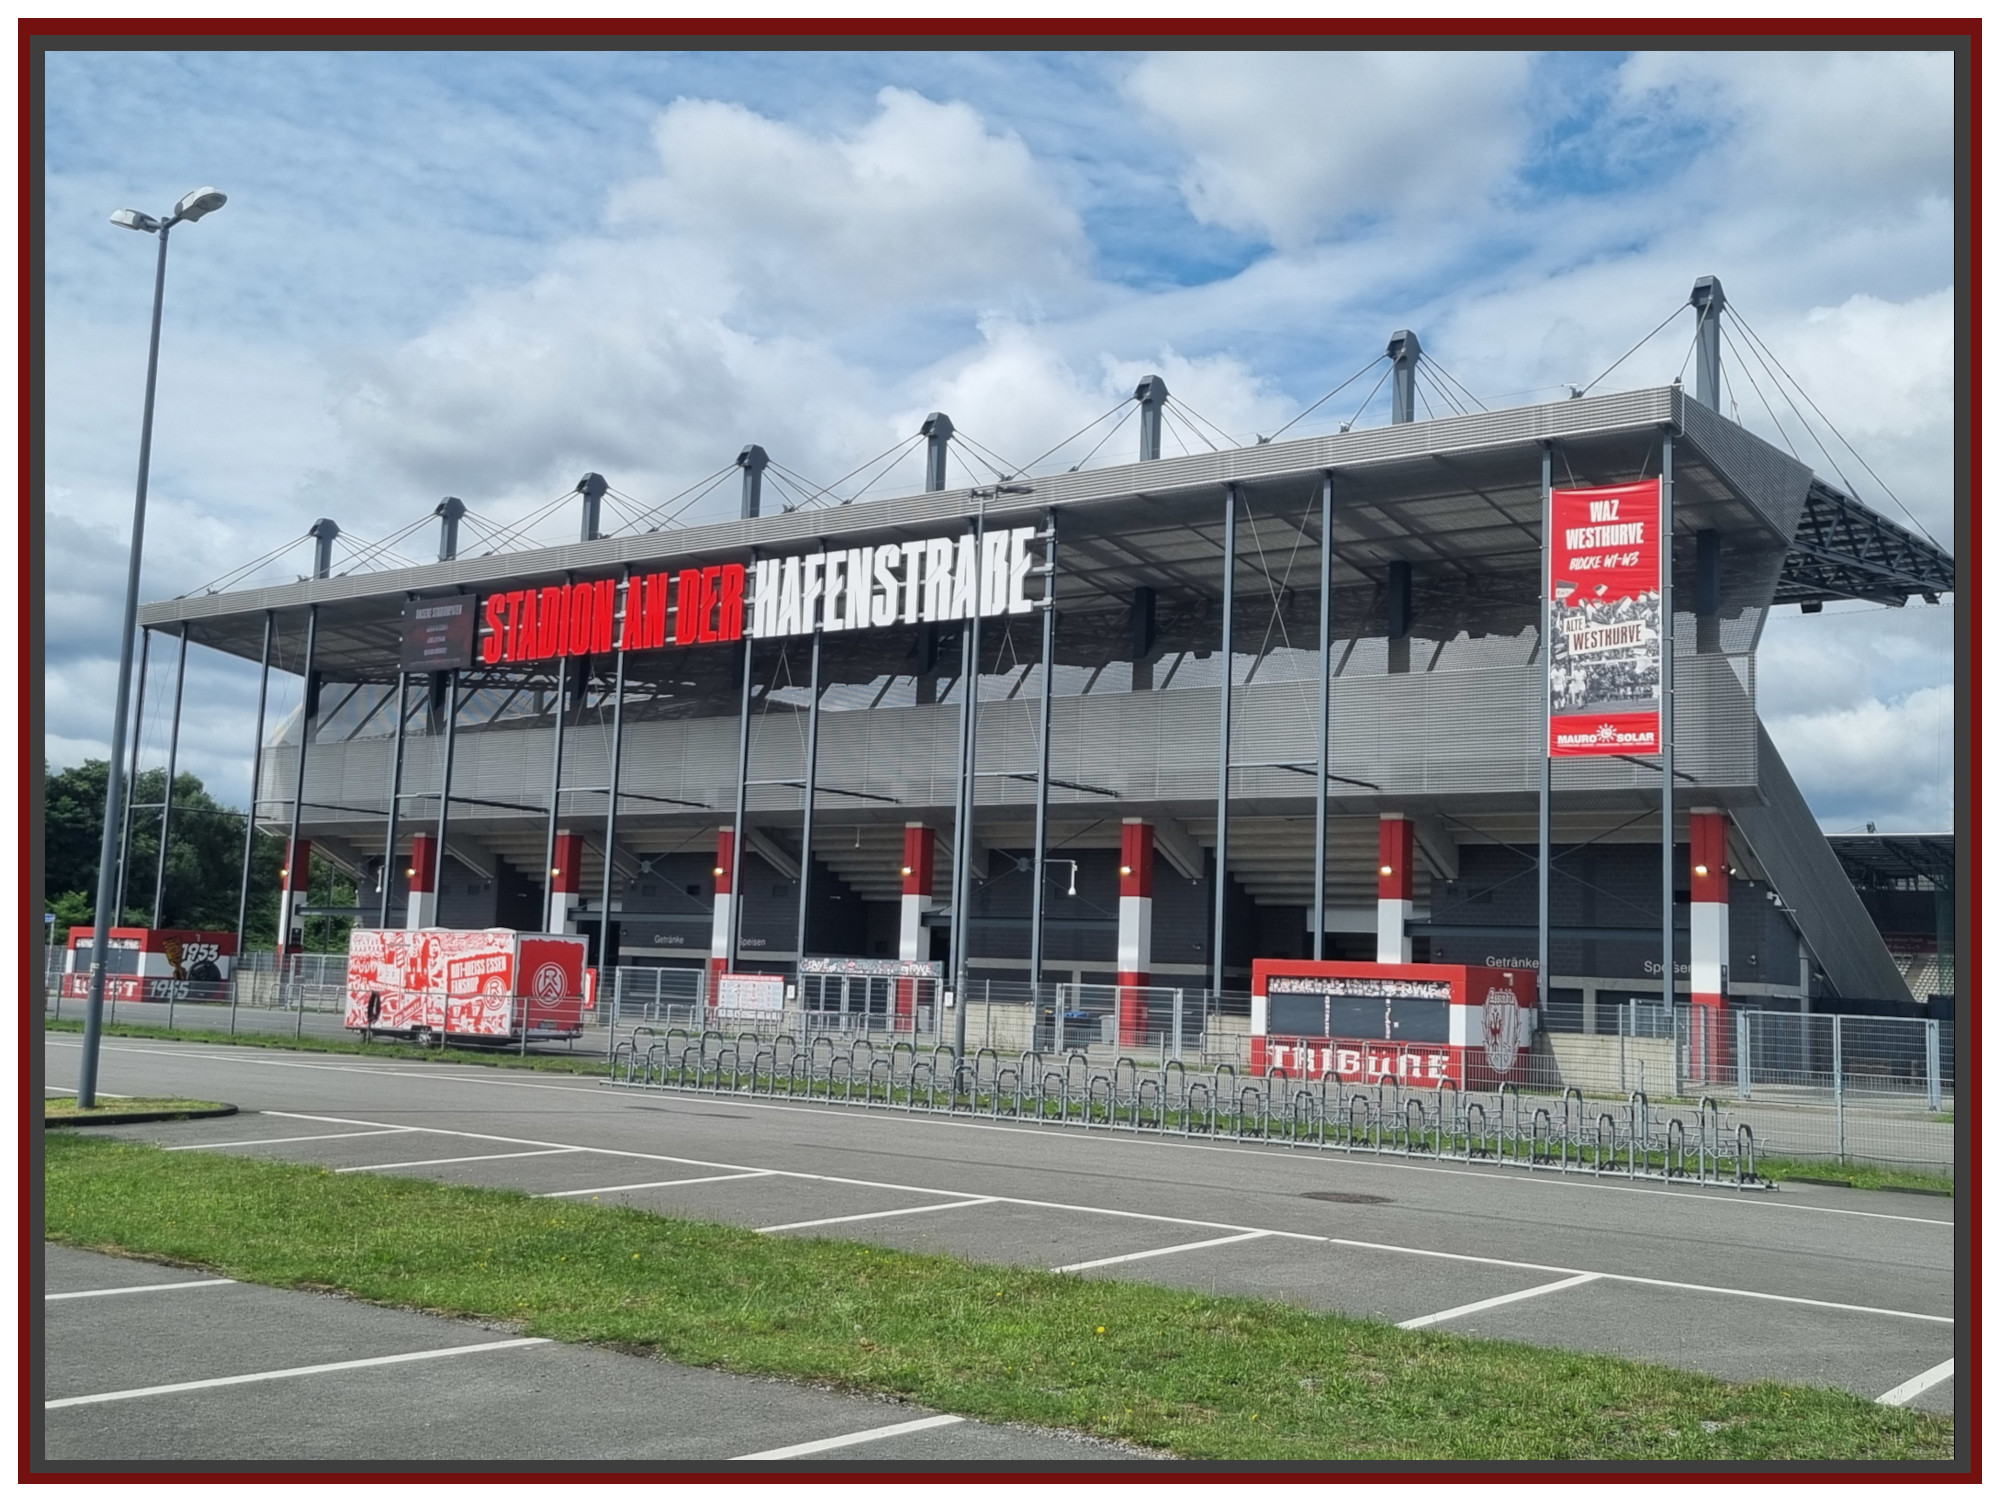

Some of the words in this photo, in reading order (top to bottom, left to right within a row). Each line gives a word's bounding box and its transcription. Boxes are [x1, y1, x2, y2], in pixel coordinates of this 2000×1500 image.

[1589, 499, 1620, 523] WAZ
[1565, 522, 1645, 550] WESTKURVE
[483, 579, 616, 664] STADION
[621, 572, 668, 650] AN
[675, 563, 745, 645] DER
[1566, 618, 1583, 633] ALTE
[1573, 624, 1642, 651] WESTKURVE
[1557, 734, 1597, 744] MAURO
[1616, 732, 1655, 743] SOLAR
[181, 943, 219, 962] 1953
[1486, 956, 1540, 969] Getränke
[73, 978, 139, 997] WST
